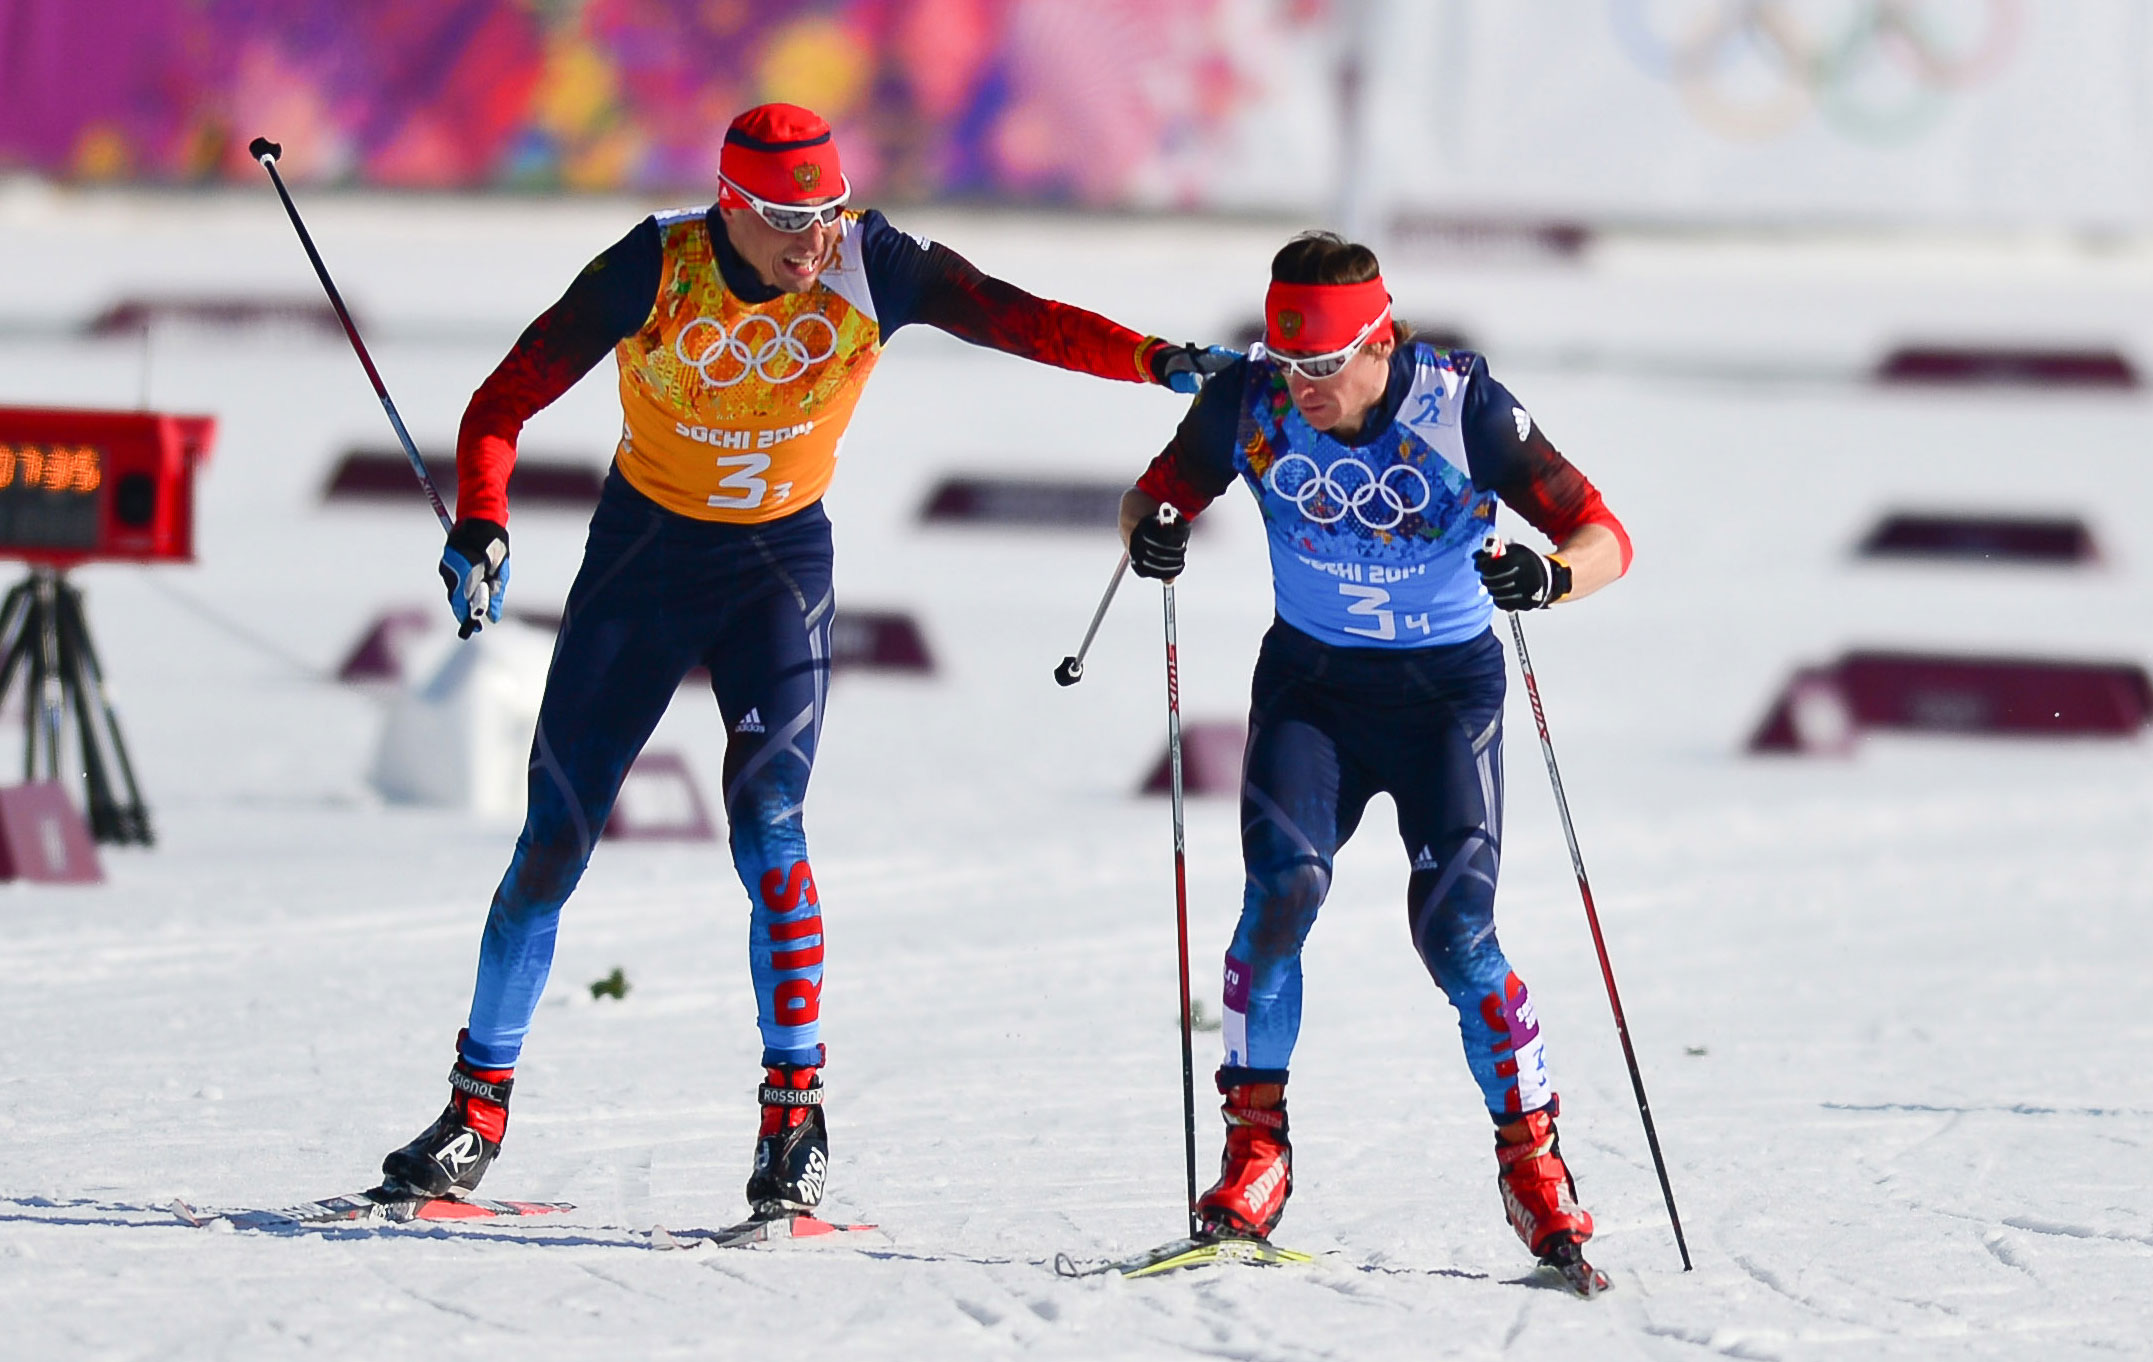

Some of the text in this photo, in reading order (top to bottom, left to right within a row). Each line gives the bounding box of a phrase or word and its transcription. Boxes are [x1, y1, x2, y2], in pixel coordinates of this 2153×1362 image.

[676, 422, 750, 449] SOCHI
[707, 452, 793, 509] 3 3
[1338, 583, 1431, 641] 3 4
[735, 724, 766, 733] adidas
[760, 860, 824, 1027] RUS
[450, 1070, 495, 1099] SSIGNOL
[763, 1088, 824, 1104] ROSSIGNO
